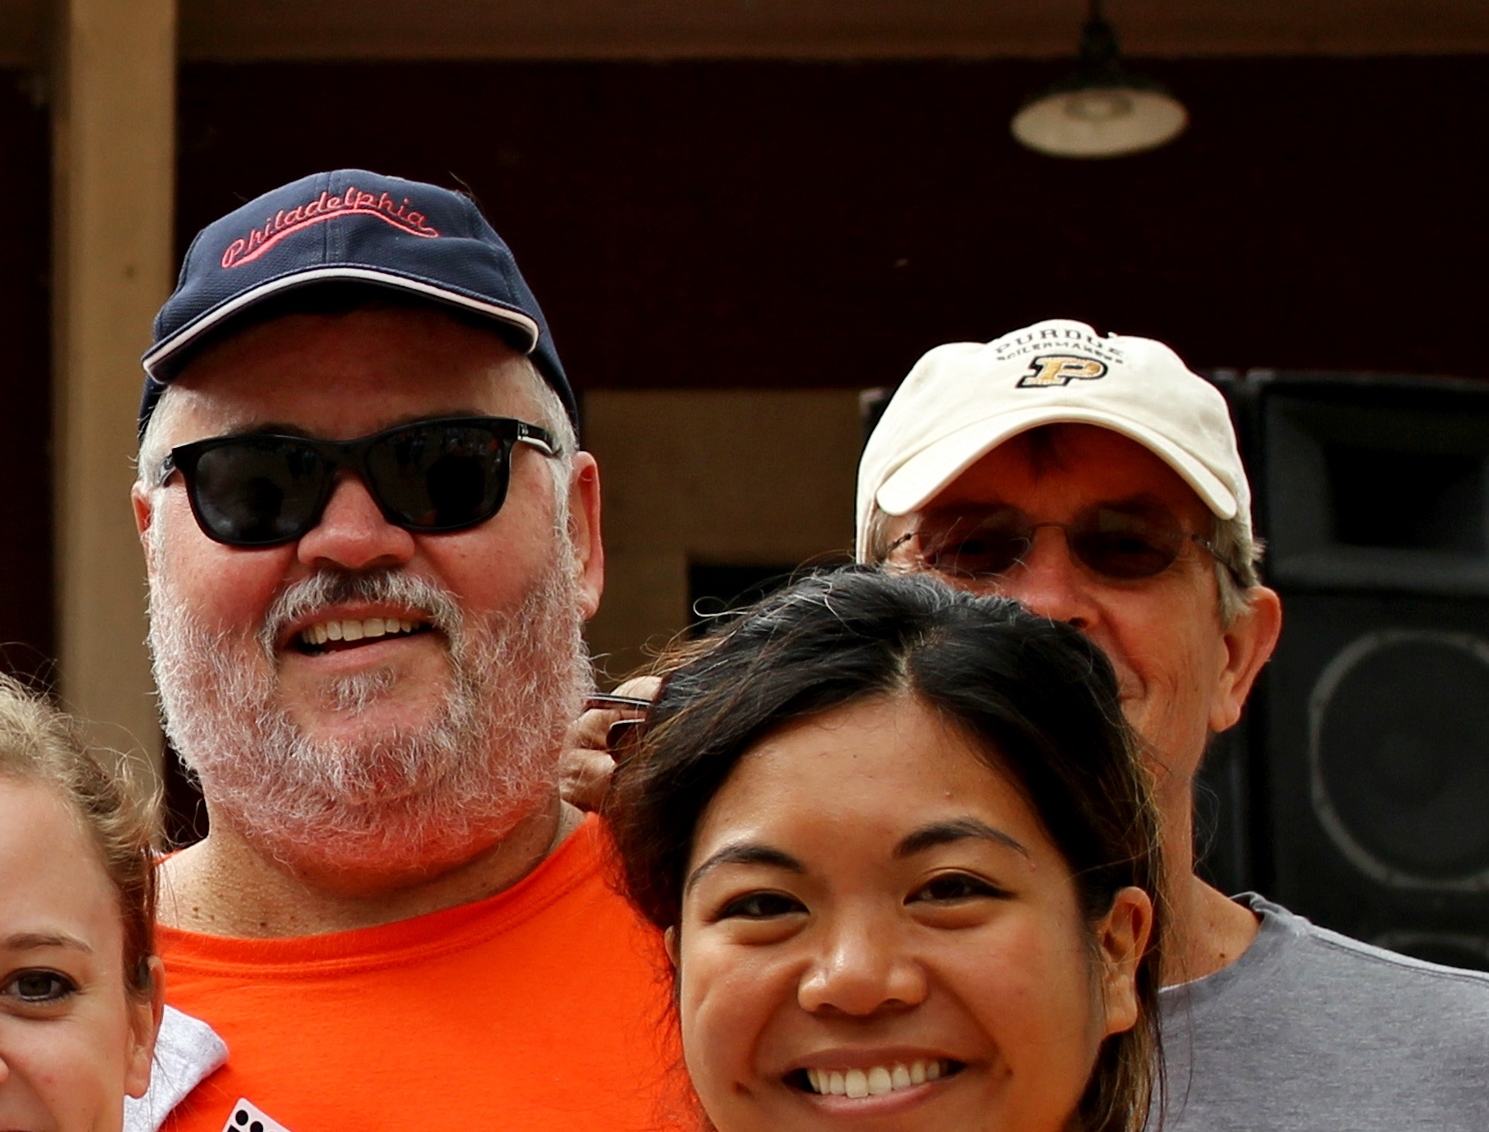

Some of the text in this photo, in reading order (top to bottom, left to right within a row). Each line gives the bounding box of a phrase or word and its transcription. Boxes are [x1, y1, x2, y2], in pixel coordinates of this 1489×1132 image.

[221, 186, 439, 268] Philadelphia
[995, 328, 1124, 356] PURDUE
[1015, 353, 1109, 388] P
